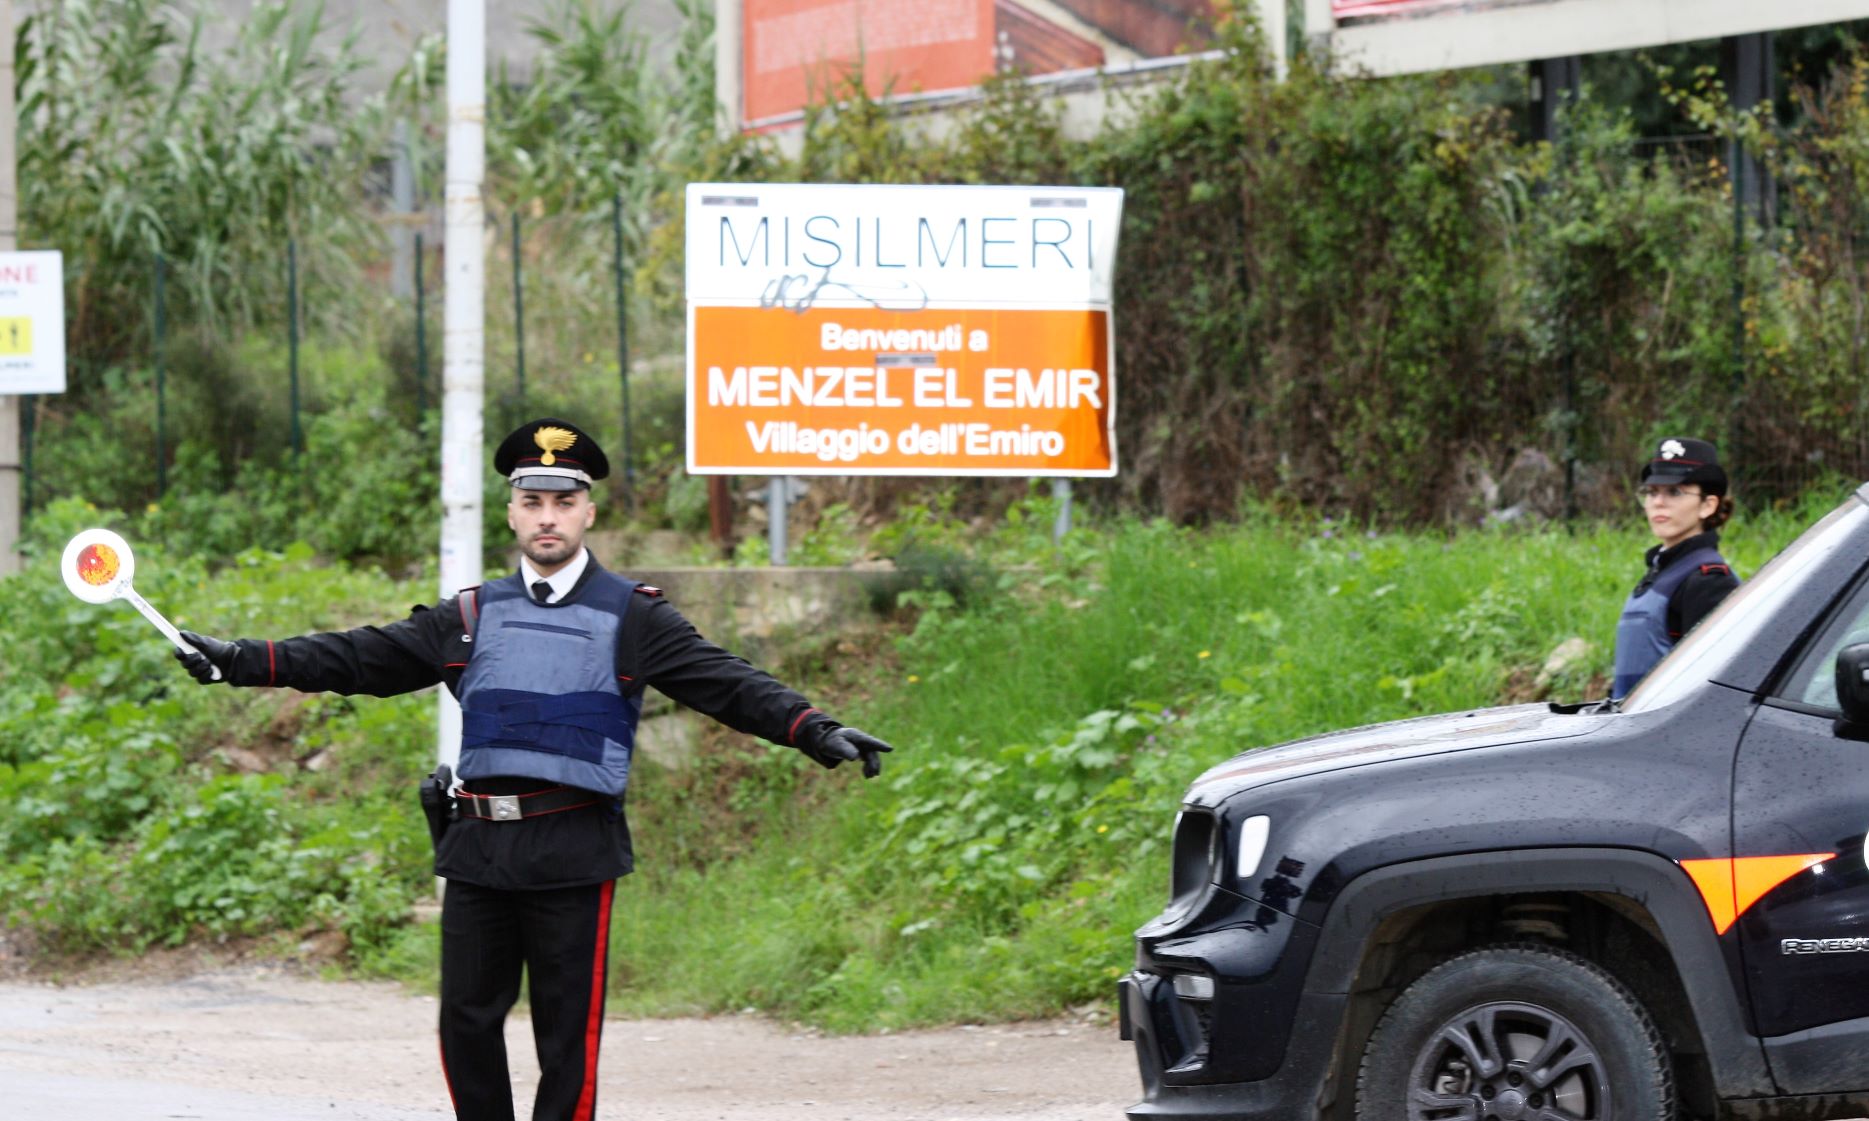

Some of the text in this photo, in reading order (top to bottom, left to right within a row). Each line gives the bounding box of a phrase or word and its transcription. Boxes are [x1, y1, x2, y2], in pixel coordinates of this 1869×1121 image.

[720, 215, 1092, 269] MISILMERI
[821, 323, 988, 351] Benvenuti a
[708, 367, 1102, 409] MENZEL EL EMIR
[746, 421, 1064, 461] Villaggio dell'Emiro
